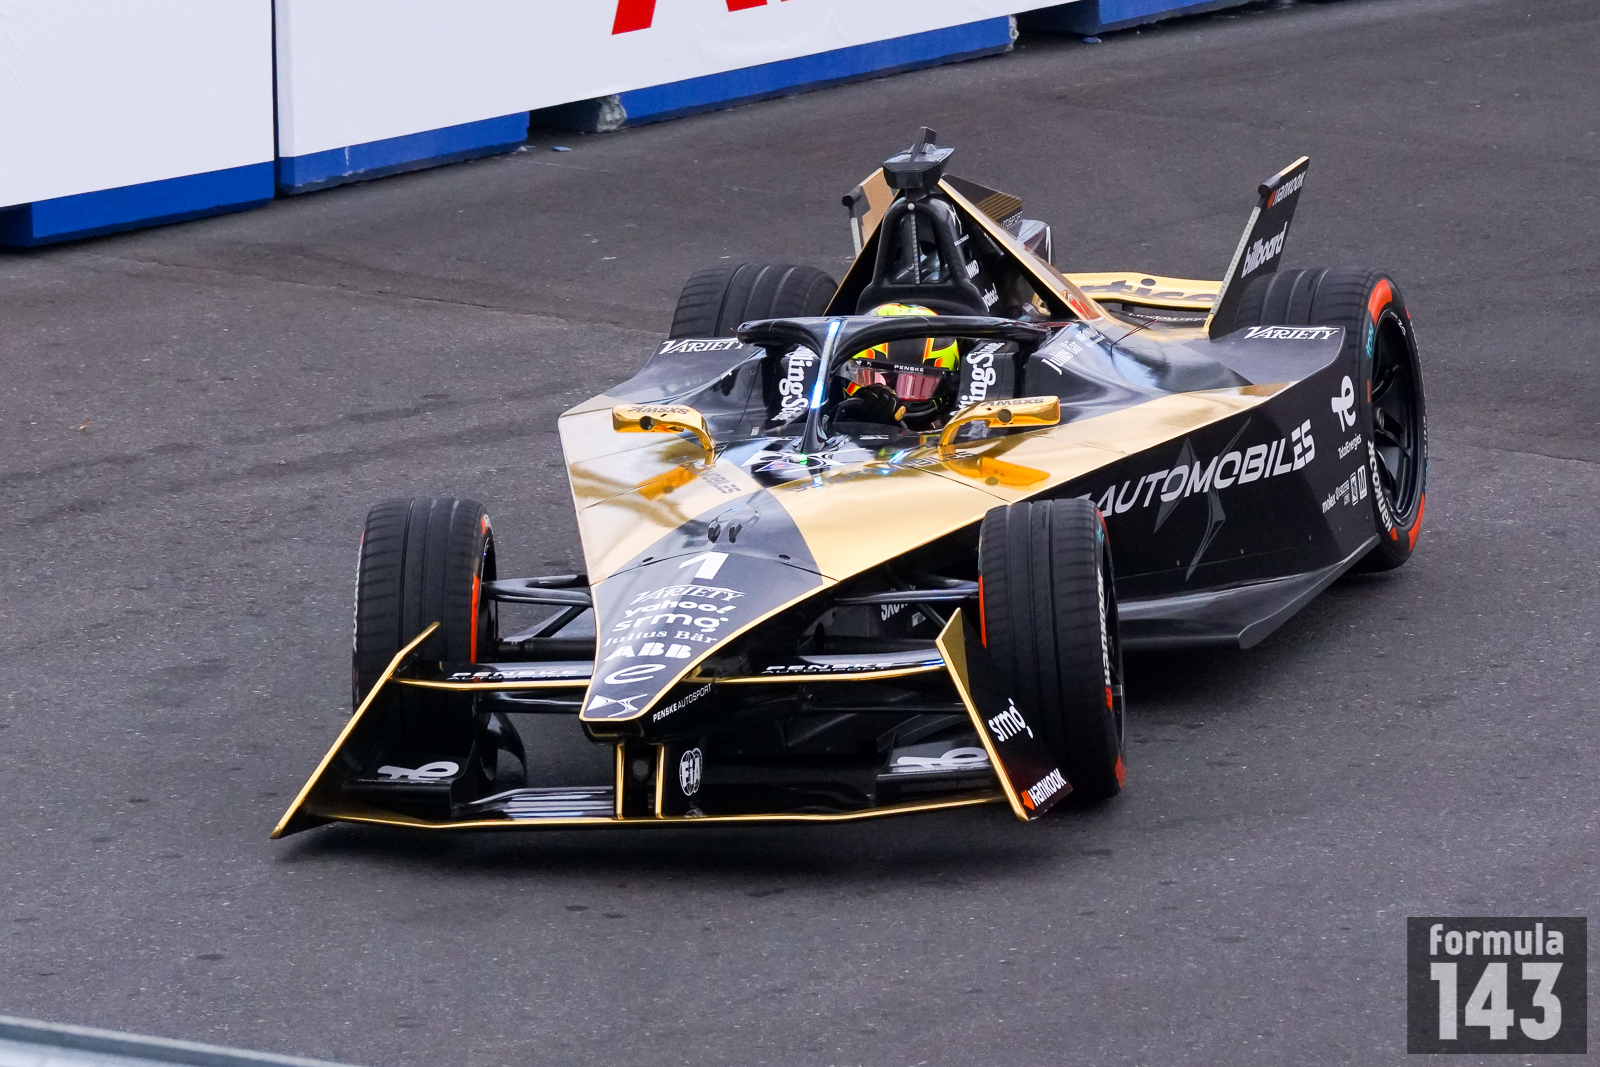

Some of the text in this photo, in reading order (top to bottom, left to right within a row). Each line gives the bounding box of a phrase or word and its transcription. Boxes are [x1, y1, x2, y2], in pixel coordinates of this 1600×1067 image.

[1241, 221, 1287, 278] billboard
[1244, 326, 1340, 340] VARIETY
[893, 364, 925, 373] PENSKE
[1337, 433, 1362, 460] TotalEnergies
[1096, 419, 1315, 518] AUTOMOBILES
[678, 551, 730, 580] 1
[629, 584, 746, 605] VARIETY
[624, 599, 737, 618] yahoo!
[612, 613, 729, 633] srmg
[603, 630, 718, 647] Julius Bär
[603, 642, 692, 662] ABB
[652, 683, 712, 723] PENSKE AUTOSPORT
